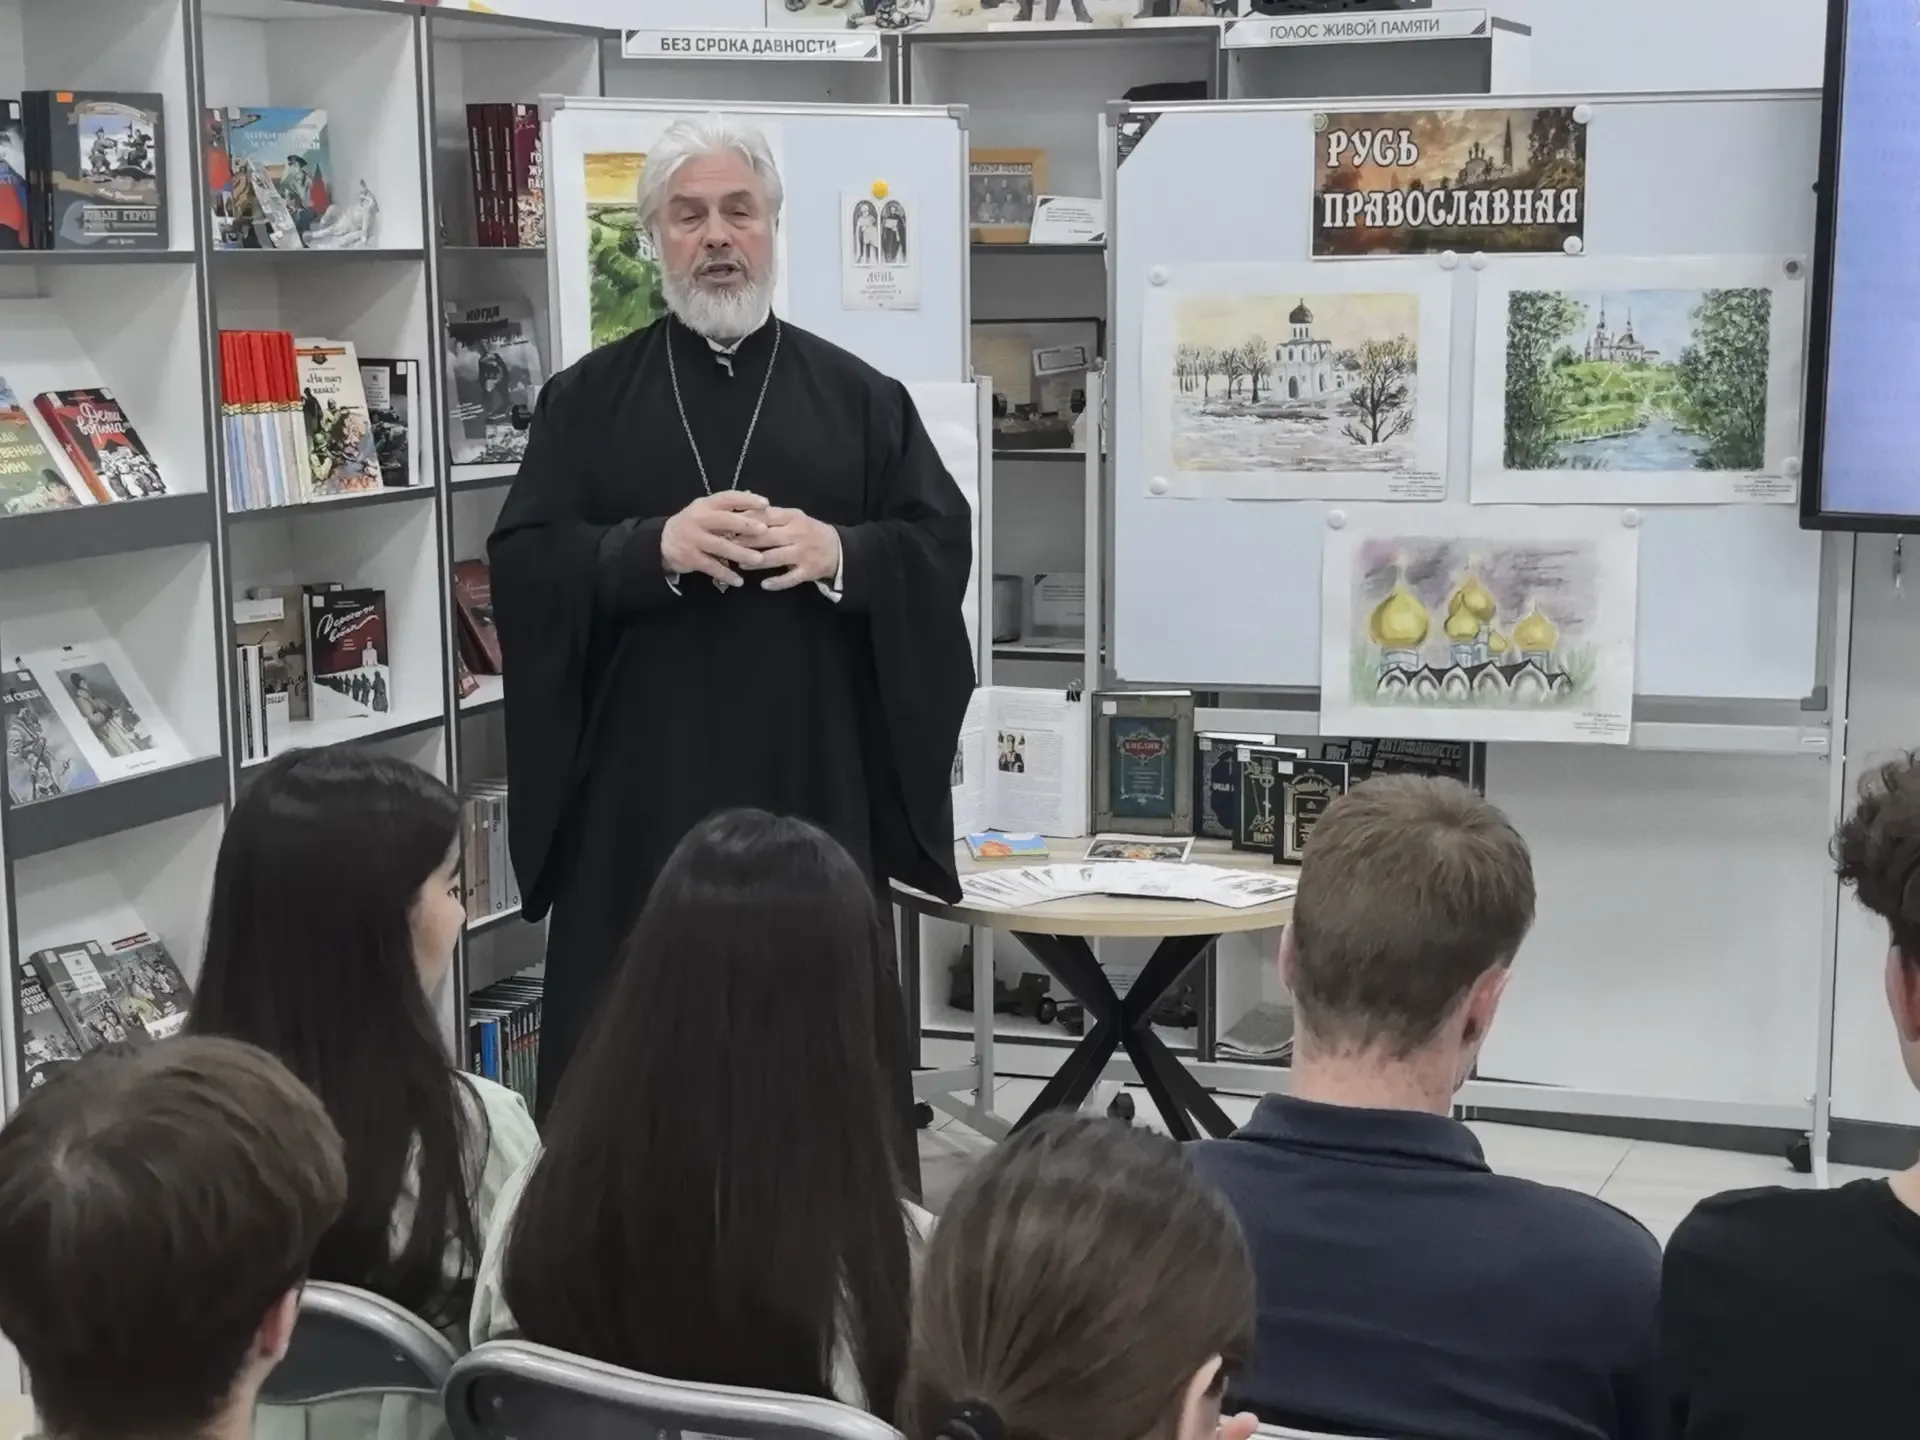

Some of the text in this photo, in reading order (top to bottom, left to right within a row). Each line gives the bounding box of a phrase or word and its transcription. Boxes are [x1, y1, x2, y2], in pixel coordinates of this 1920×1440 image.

[1270, 18, 1440, 39] ГОЛОС ЖИВОЙ ПАМЯТИ
[660, 37, 837, 54] БЕЗ СРОКА ДАВНОСТИ
[1326, 129, 1419, 168] РУСЬ
[1322, 187, 1579, 228] ПРАВОСЛАВНАЯ
[79, 402, 123, 424] Дети
[76, 415, 126, 444] ворона
[0, 443, 46, 459] ВЕННАЯ
[0, 459, 33, 475] ОЙНА
